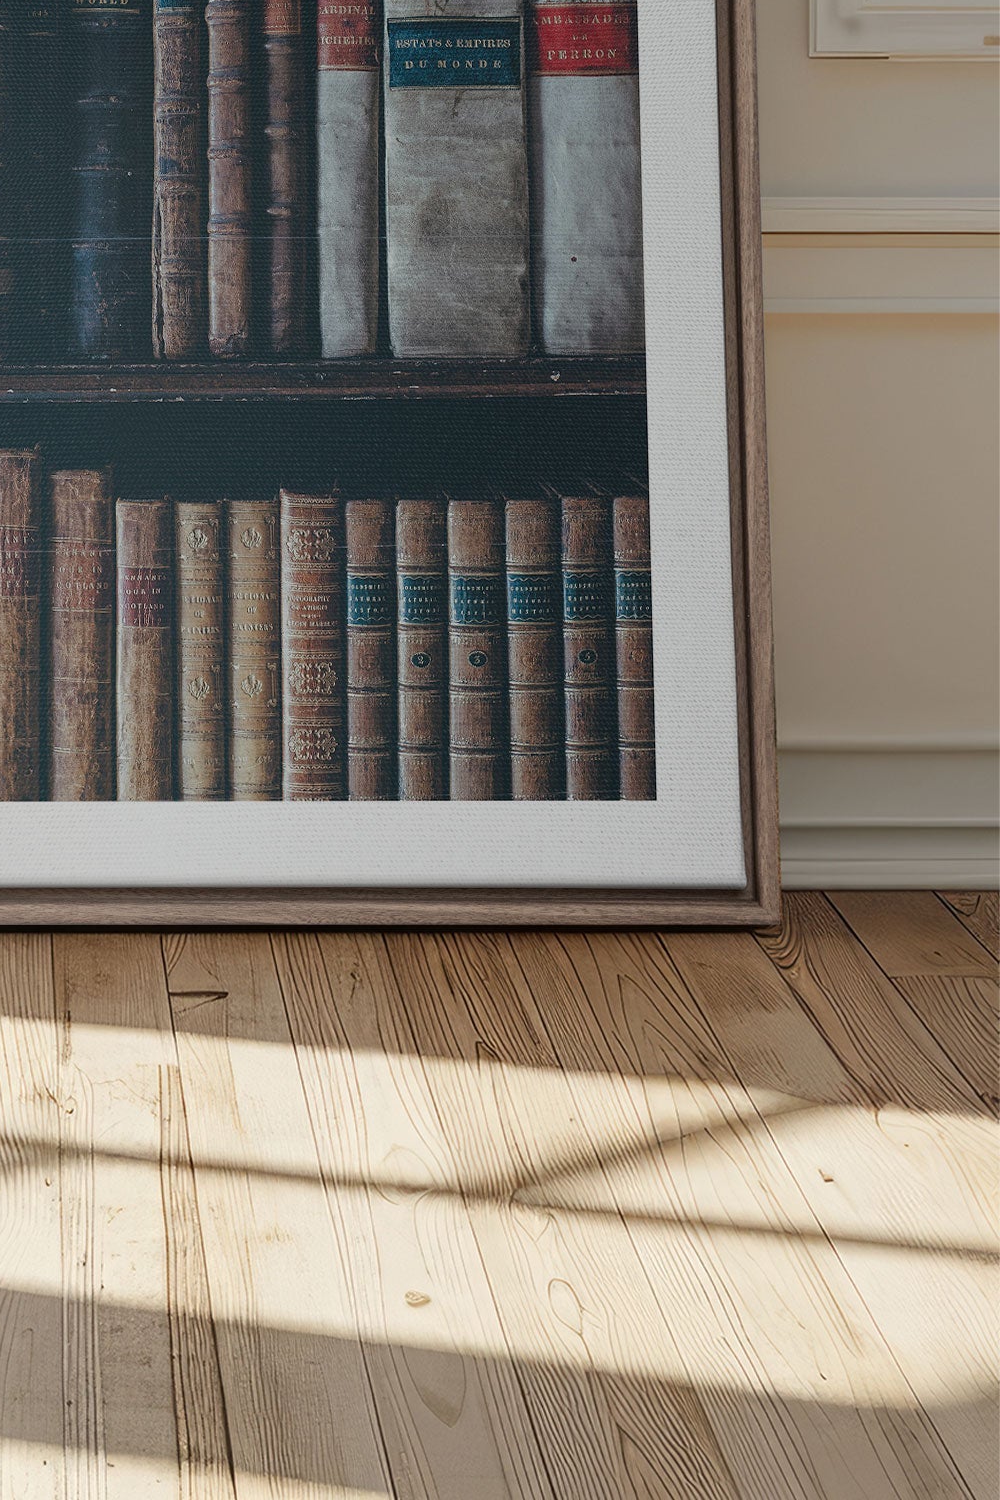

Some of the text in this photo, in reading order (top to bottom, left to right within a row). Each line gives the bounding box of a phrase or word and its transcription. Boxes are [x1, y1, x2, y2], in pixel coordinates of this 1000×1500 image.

[395, 39, 511, 49] ESTATS & EMPIRES
[547, 48, 617, 61] PERRON
[405, 60, 502, 70] DU MONDE
